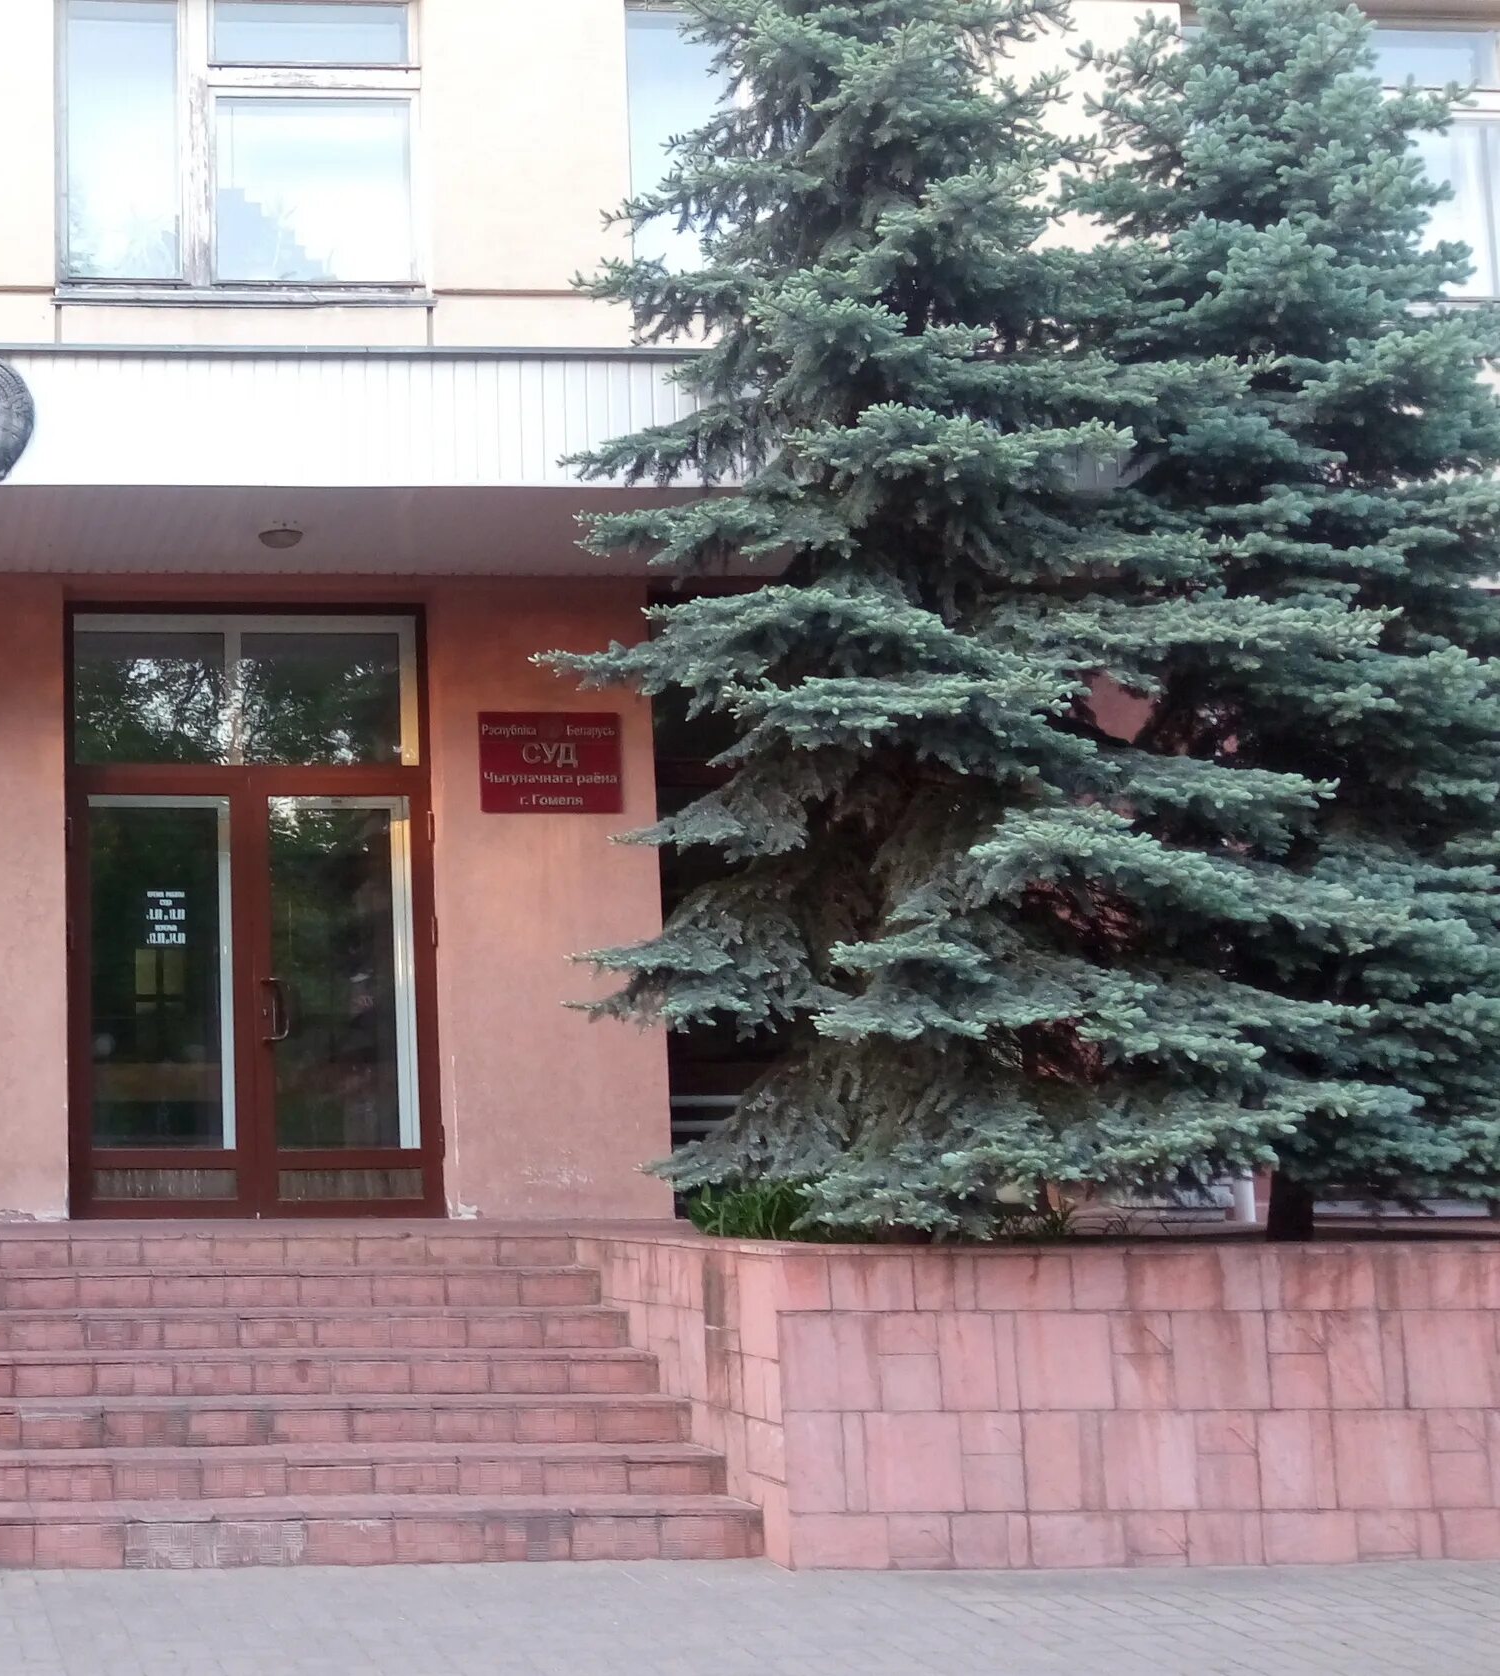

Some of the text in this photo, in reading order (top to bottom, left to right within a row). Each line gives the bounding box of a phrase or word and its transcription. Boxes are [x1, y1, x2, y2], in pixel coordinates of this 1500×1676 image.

[482, 724, 615, 738] Рэспубліка Беларусь
[522, 742, 578, 768] СУД
[484, 772, 618, 786] Чыгуначнага раёна
[519, 794, 583, 806] г. Гомеля
